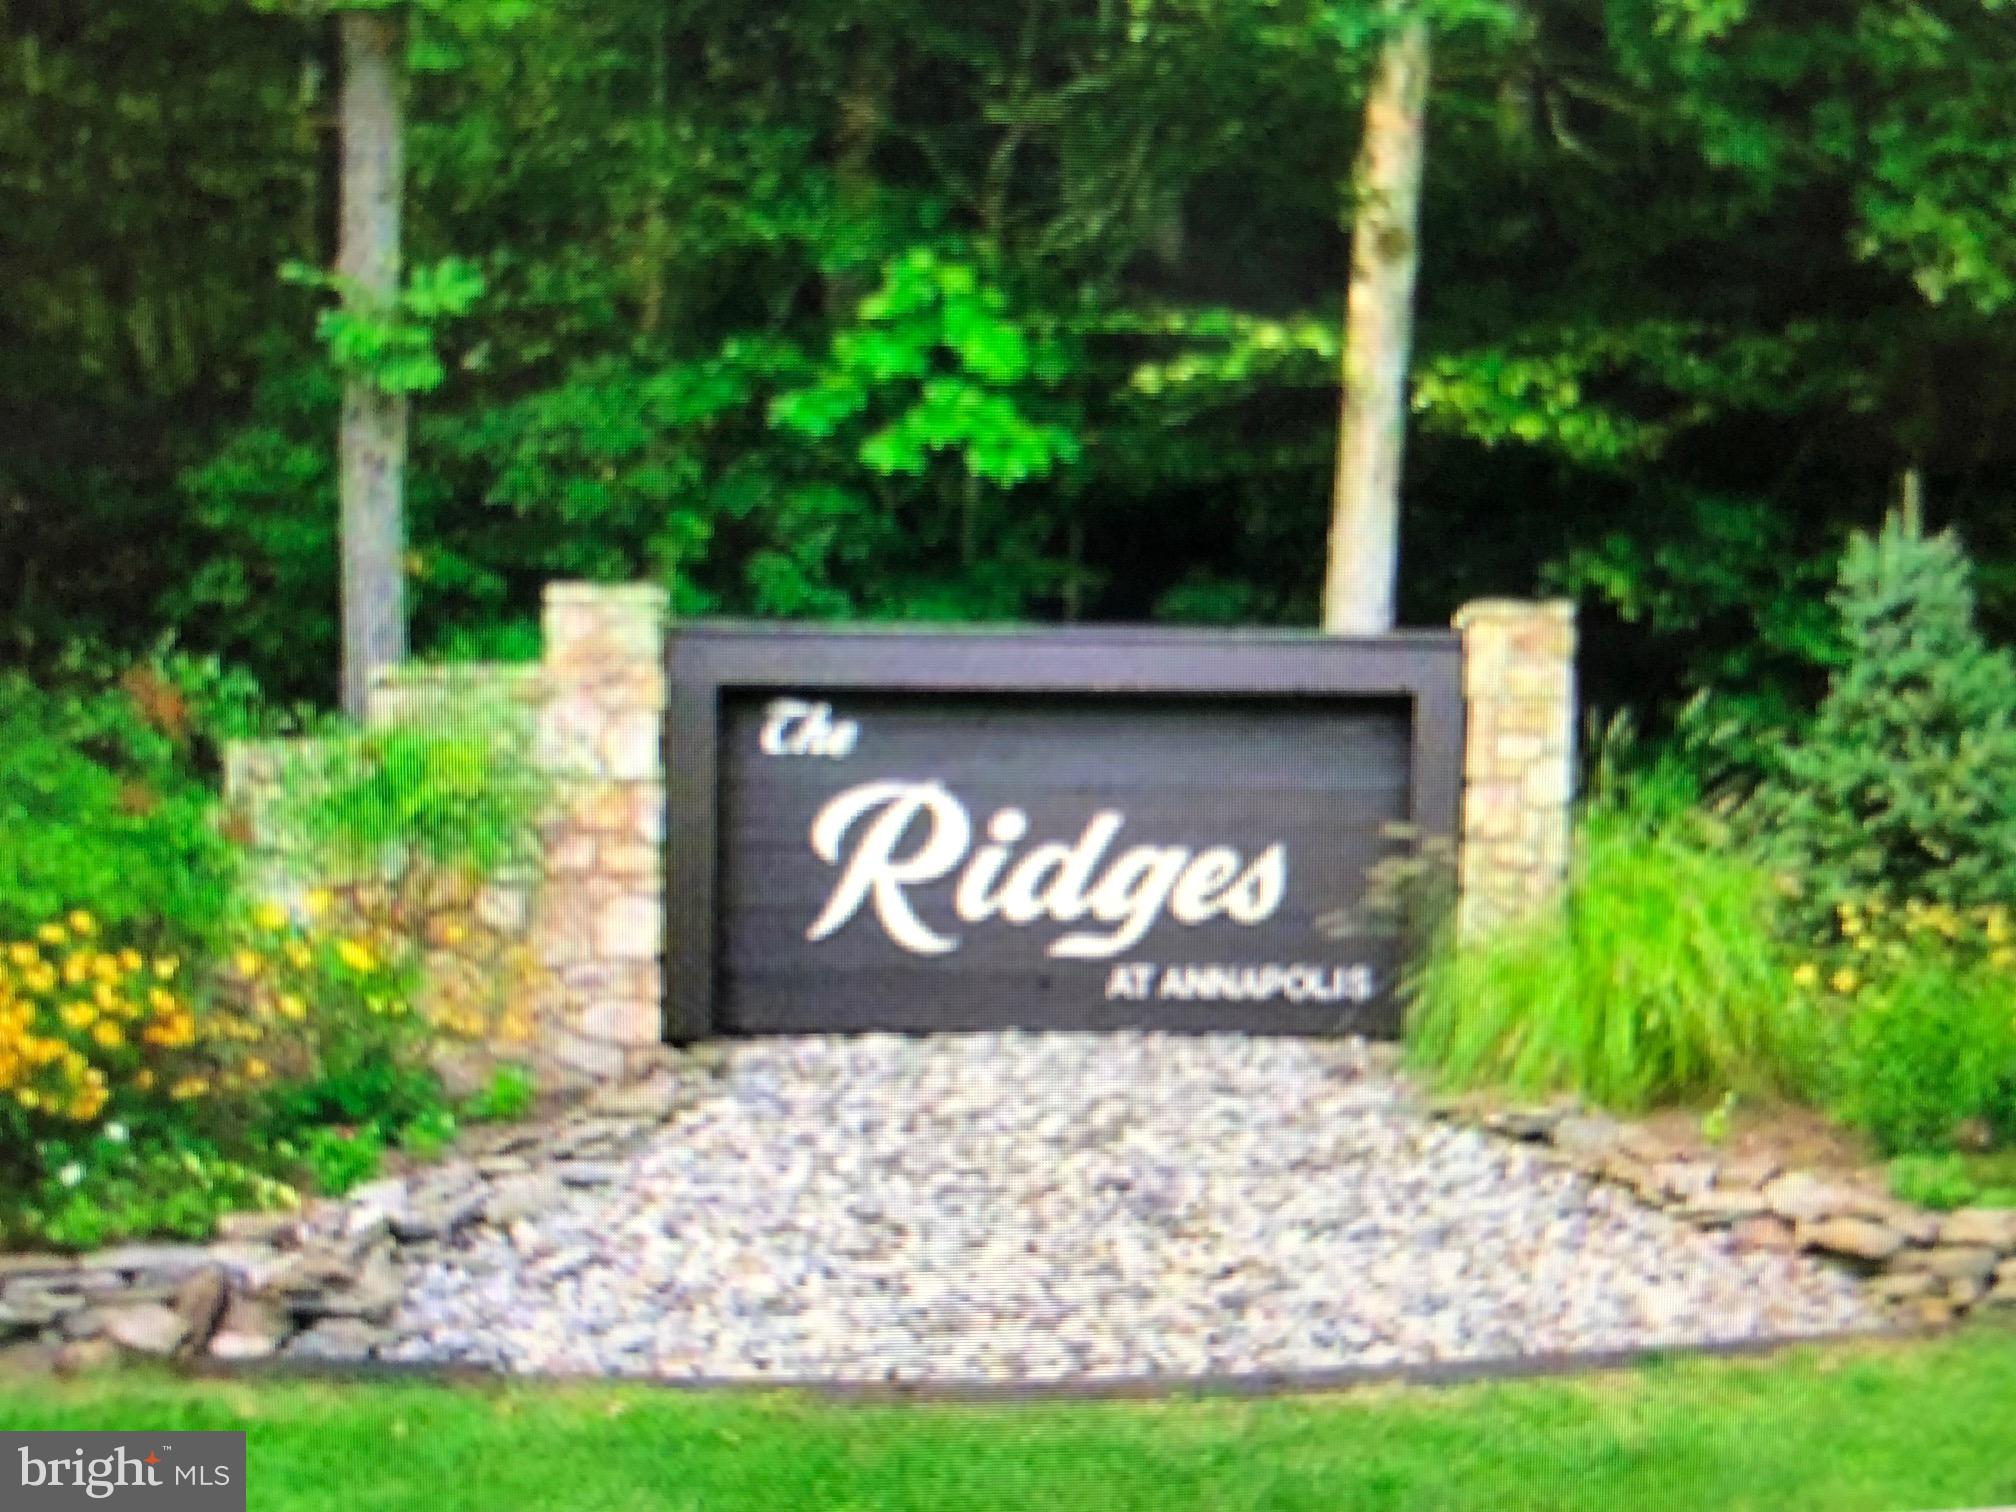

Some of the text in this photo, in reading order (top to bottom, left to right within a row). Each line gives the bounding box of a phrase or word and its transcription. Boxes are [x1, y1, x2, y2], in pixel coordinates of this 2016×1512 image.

[759, 699, 860, 759] The
[806, 780, 1288, 958] Ridges
[1105, 962, 1375, 1003] AT ANNAPOLIS
